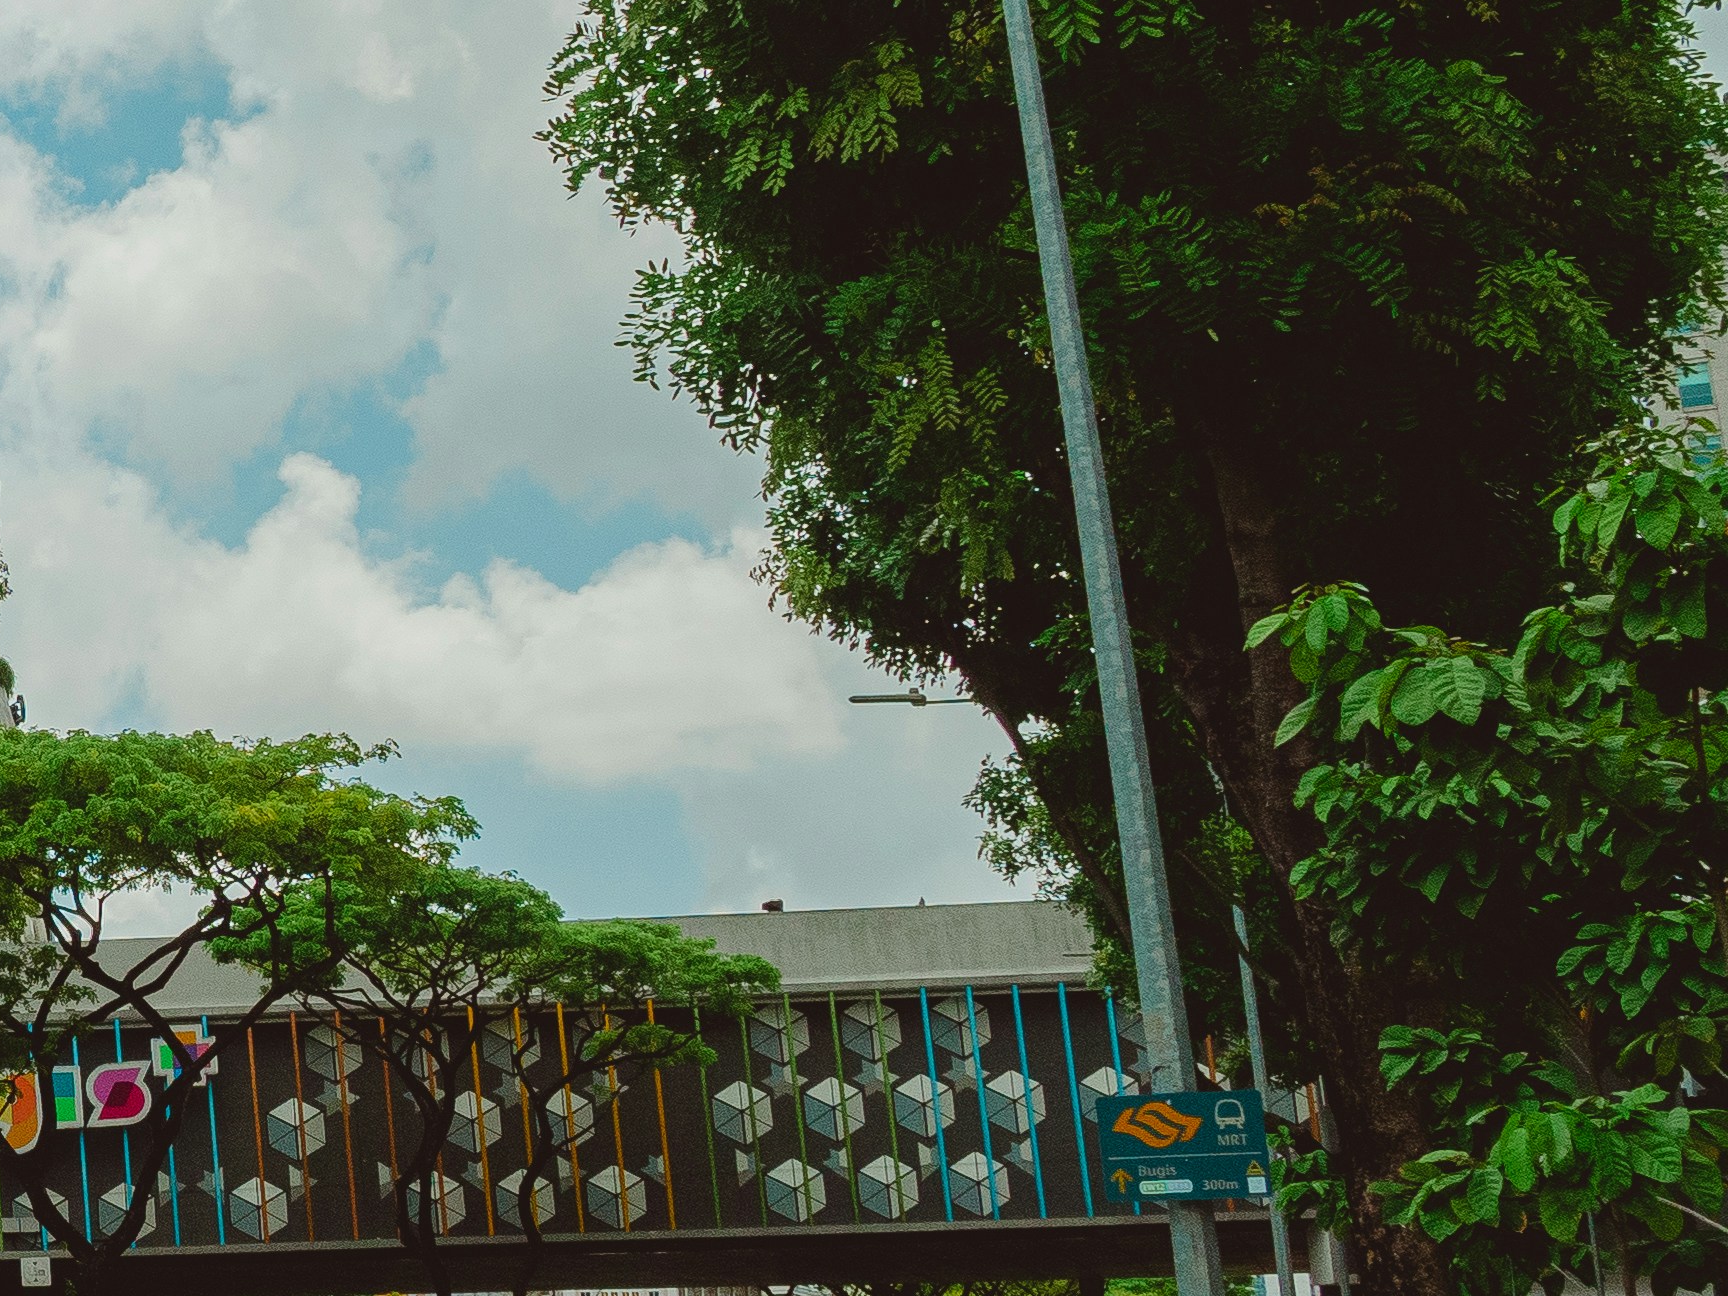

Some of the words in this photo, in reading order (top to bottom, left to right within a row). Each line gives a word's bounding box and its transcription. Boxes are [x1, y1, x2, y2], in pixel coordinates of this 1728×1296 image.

[1216, 1133, 1247, 1146] MRT
[1137, 1164, 1177, 1178] Bugis
[1202, 1179, 1239, 1191] 300m
